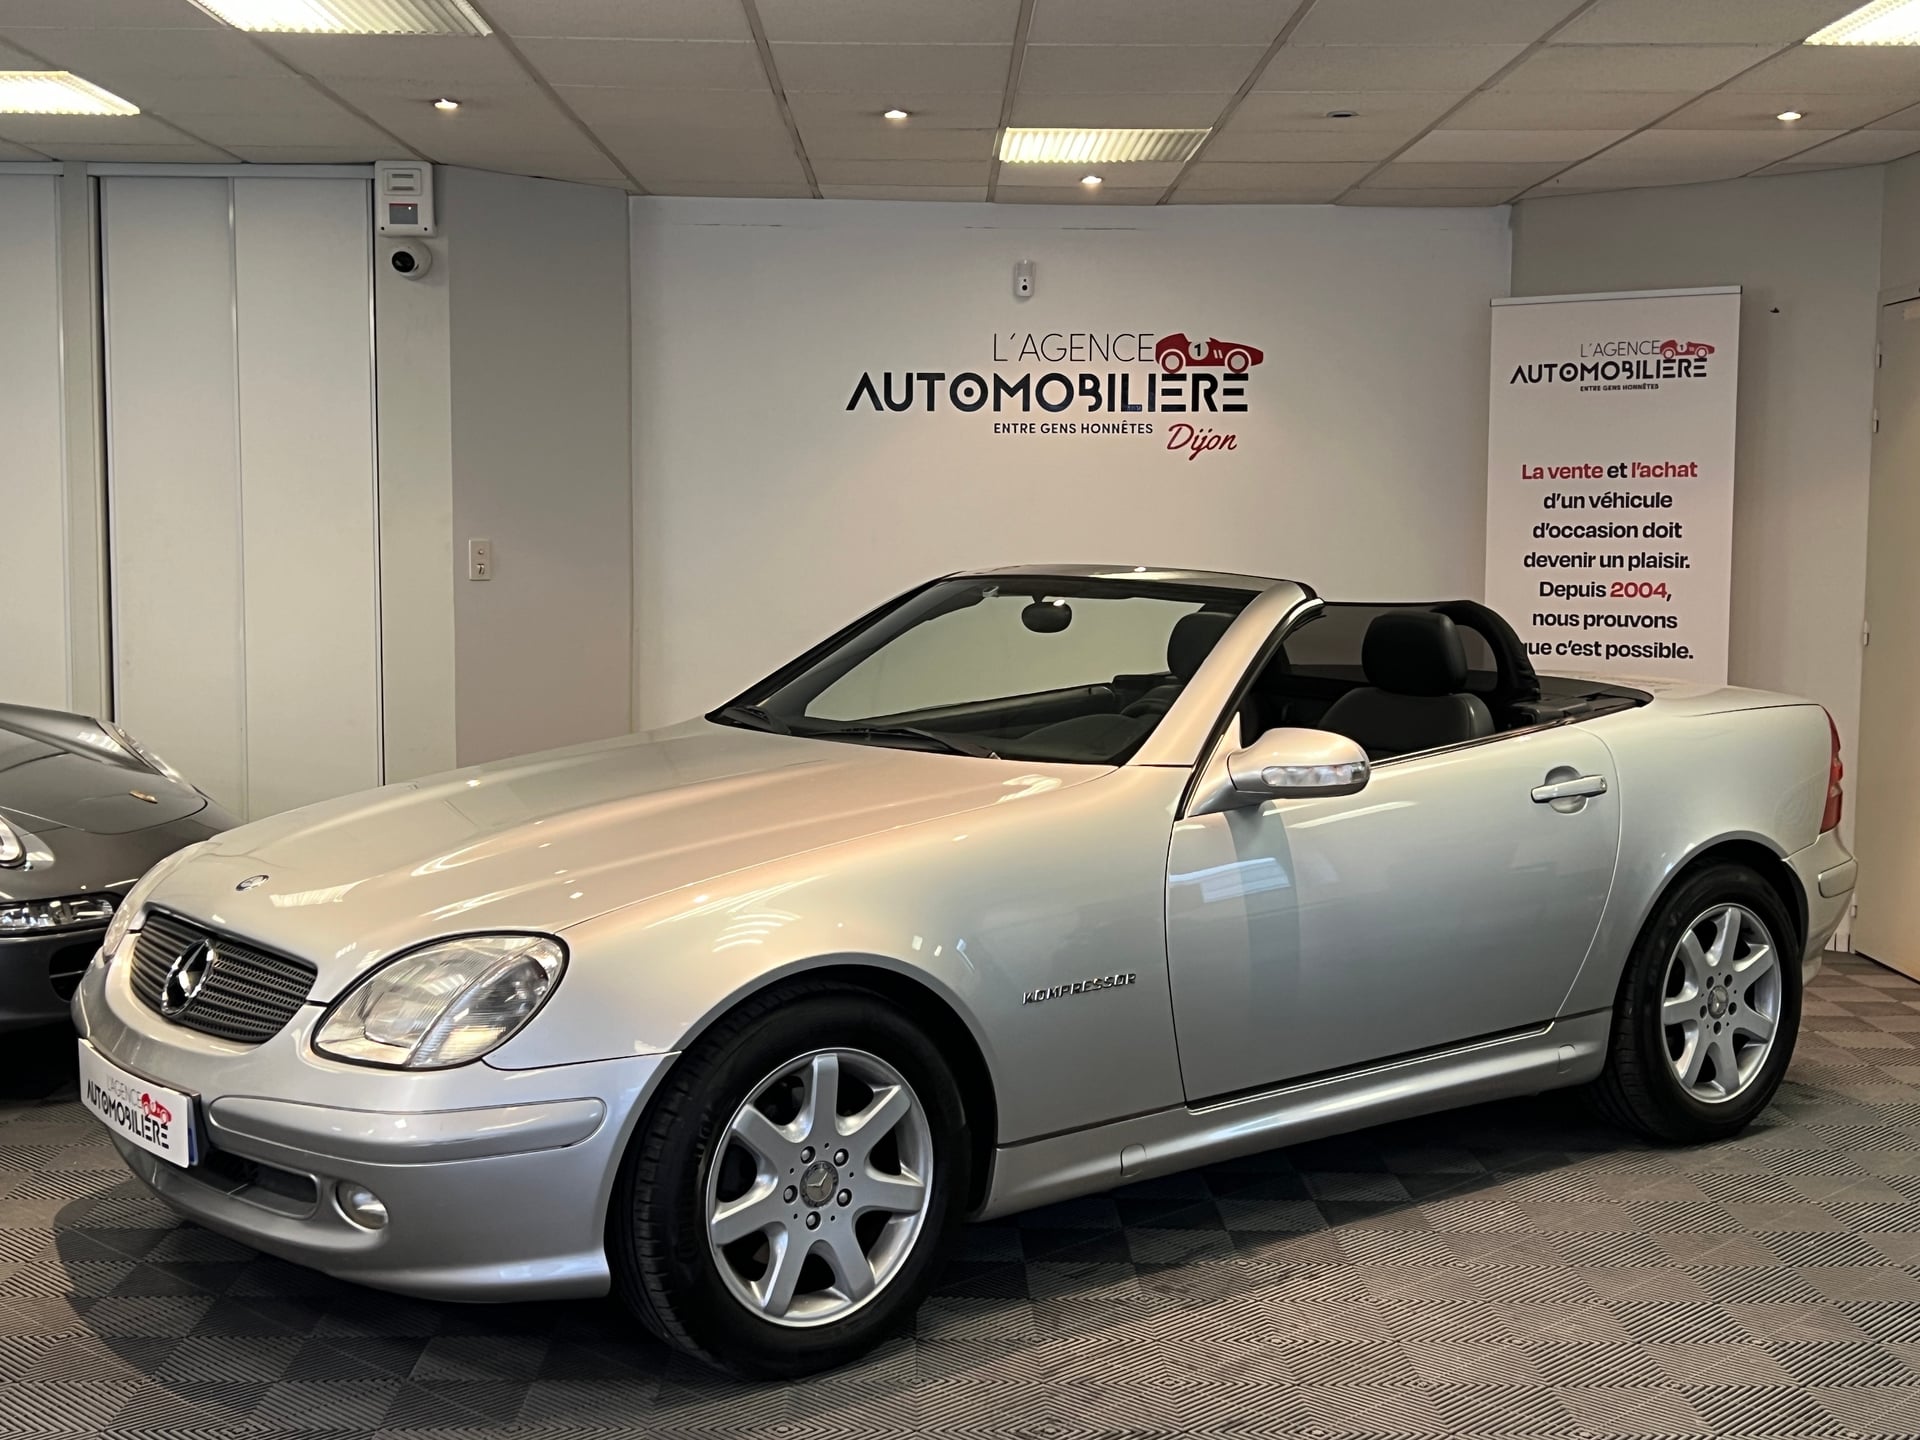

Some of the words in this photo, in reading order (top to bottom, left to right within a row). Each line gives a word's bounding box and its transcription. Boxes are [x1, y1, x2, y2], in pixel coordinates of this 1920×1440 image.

[993, 333, 1155, 362] L'AGENCE
[1580, 340, 1660, 358] L'AGENCE
[994, 423, 1036, 434] ENTRE
[1040, 423, 1077, 434] GENS
[1081, 420, 1153, 434] HONNÊTES
[1167, 423, 1238, 461] Dijon
[1522, 464, 1544, 480] La
[1547, 463, 1604, 480] vente
[1607, 462, 1628, 479] et
[1631, 461, 1698, 479] l'achat
[1543, 493, 1585, 509] d'un
[1588, 491, 1673, 509] véhicule
[1533, 523, 1638, 539] d'occasion
[1642, 522, 1683, 539] doit
[1523, 552, 1596, 568] devenir
[1600, 555, 1624, 568] un
[1628, 552, 1690, 571] plaisir.
[1539, 582, 1607, 600] Depuis
[1610, 582, 1672, 602] 2004,
[1532, 612, 1580, 627] nous
[1583, 614, 1678, 630] prouvons
[1524, 642, 1552, 656] ue
[1555, 640, 1602, 657] c'est
[1605, 642, 1694, 660] possible.
[1022, 973, 1137, 1005] KOMPRESSOR
